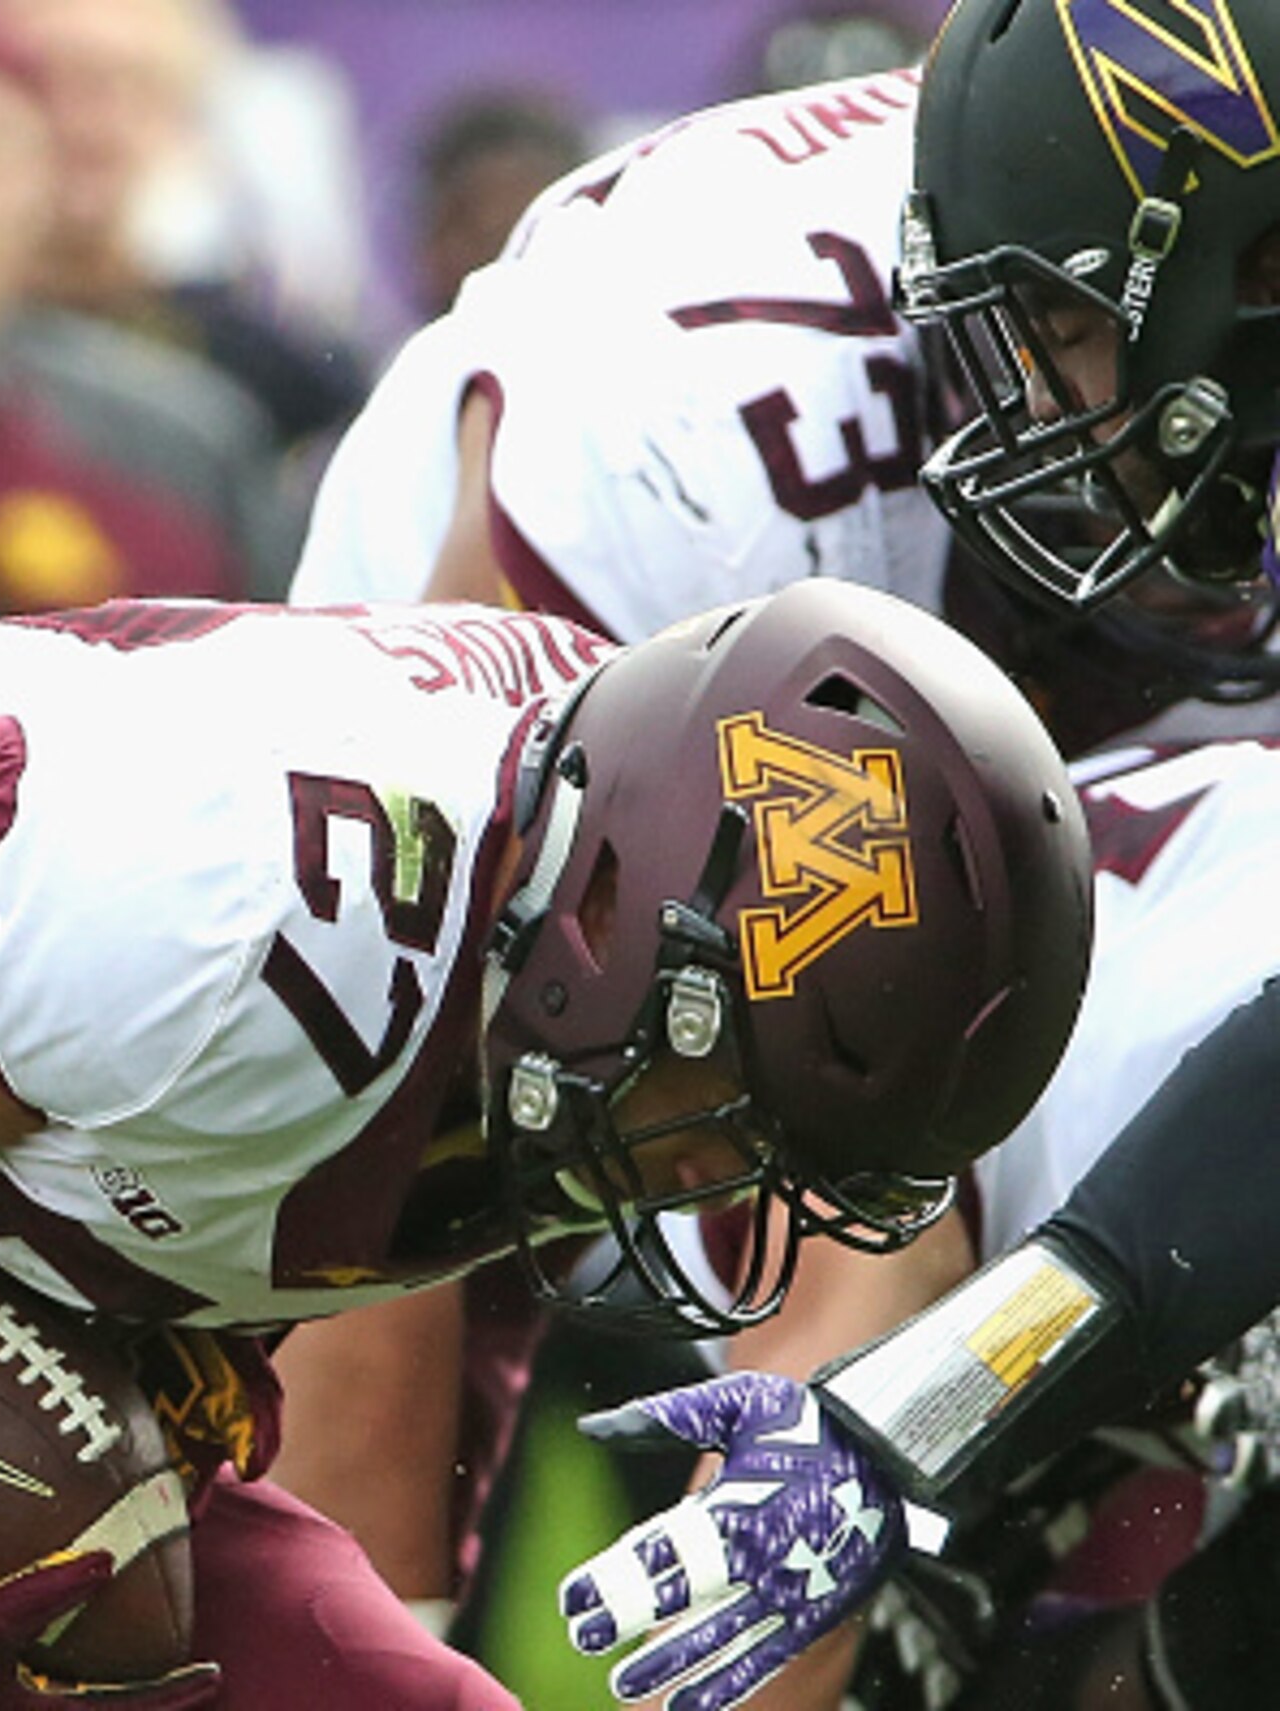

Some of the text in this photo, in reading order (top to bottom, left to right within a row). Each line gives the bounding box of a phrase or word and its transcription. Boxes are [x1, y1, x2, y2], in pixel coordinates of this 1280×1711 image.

[1053, 0, 1280, 200] N
[666, 231, 922, 522] 73
[716, 711, 918, 1000] M
